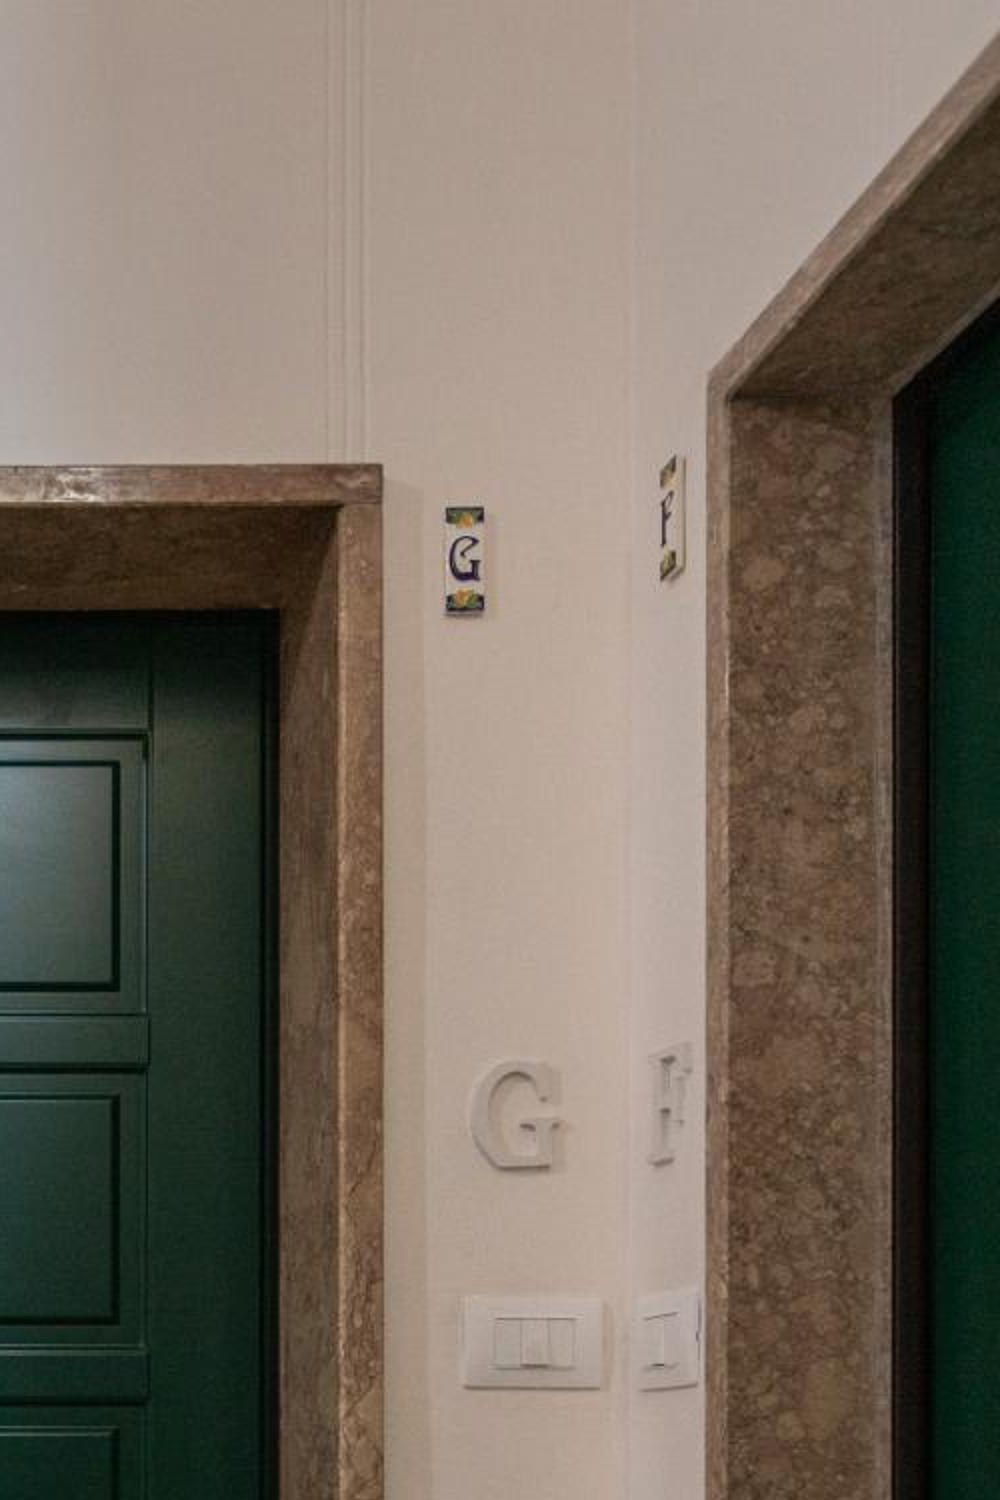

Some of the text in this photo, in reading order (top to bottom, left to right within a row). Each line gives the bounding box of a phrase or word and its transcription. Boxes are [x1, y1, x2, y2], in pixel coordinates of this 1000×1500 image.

[660, 490, 675, 548] F
[449, 535, 481, 582] G
[471, 1060, 563, 1173] G
